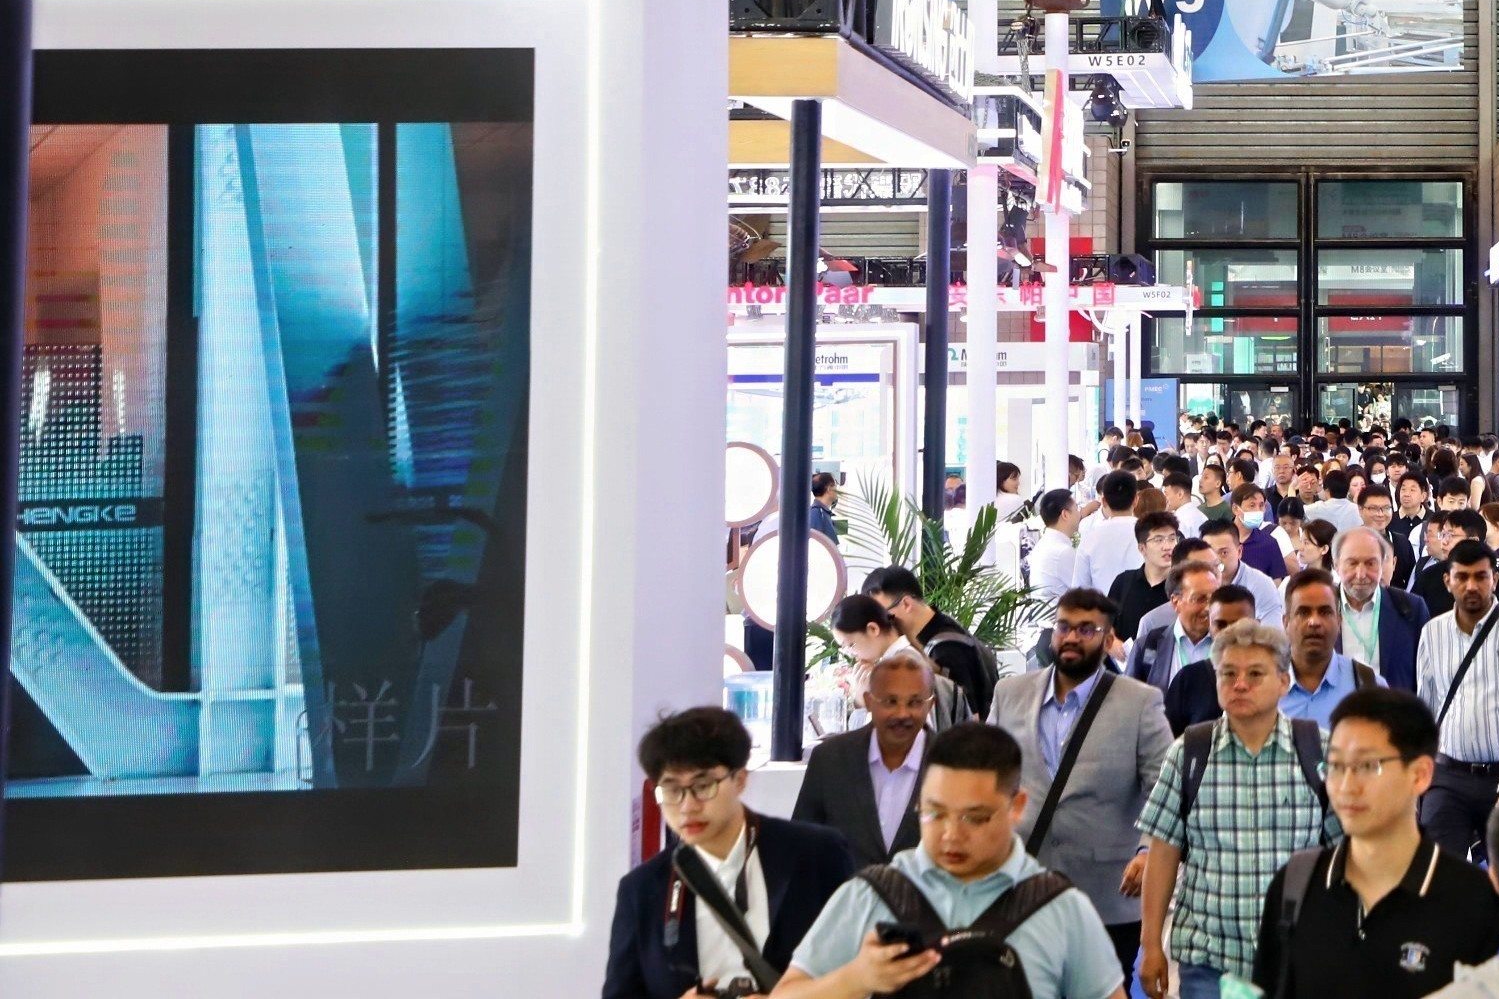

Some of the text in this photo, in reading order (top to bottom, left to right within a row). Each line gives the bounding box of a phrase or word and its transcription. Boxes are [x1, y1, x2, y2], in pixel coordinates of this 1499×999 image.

[1088, 55, 1147, 67] W5E02
[728, 281, 787, 304] nton
[1142, 290, 1171, 299] W5F02
[815, 352, 848, 365] etrohm
